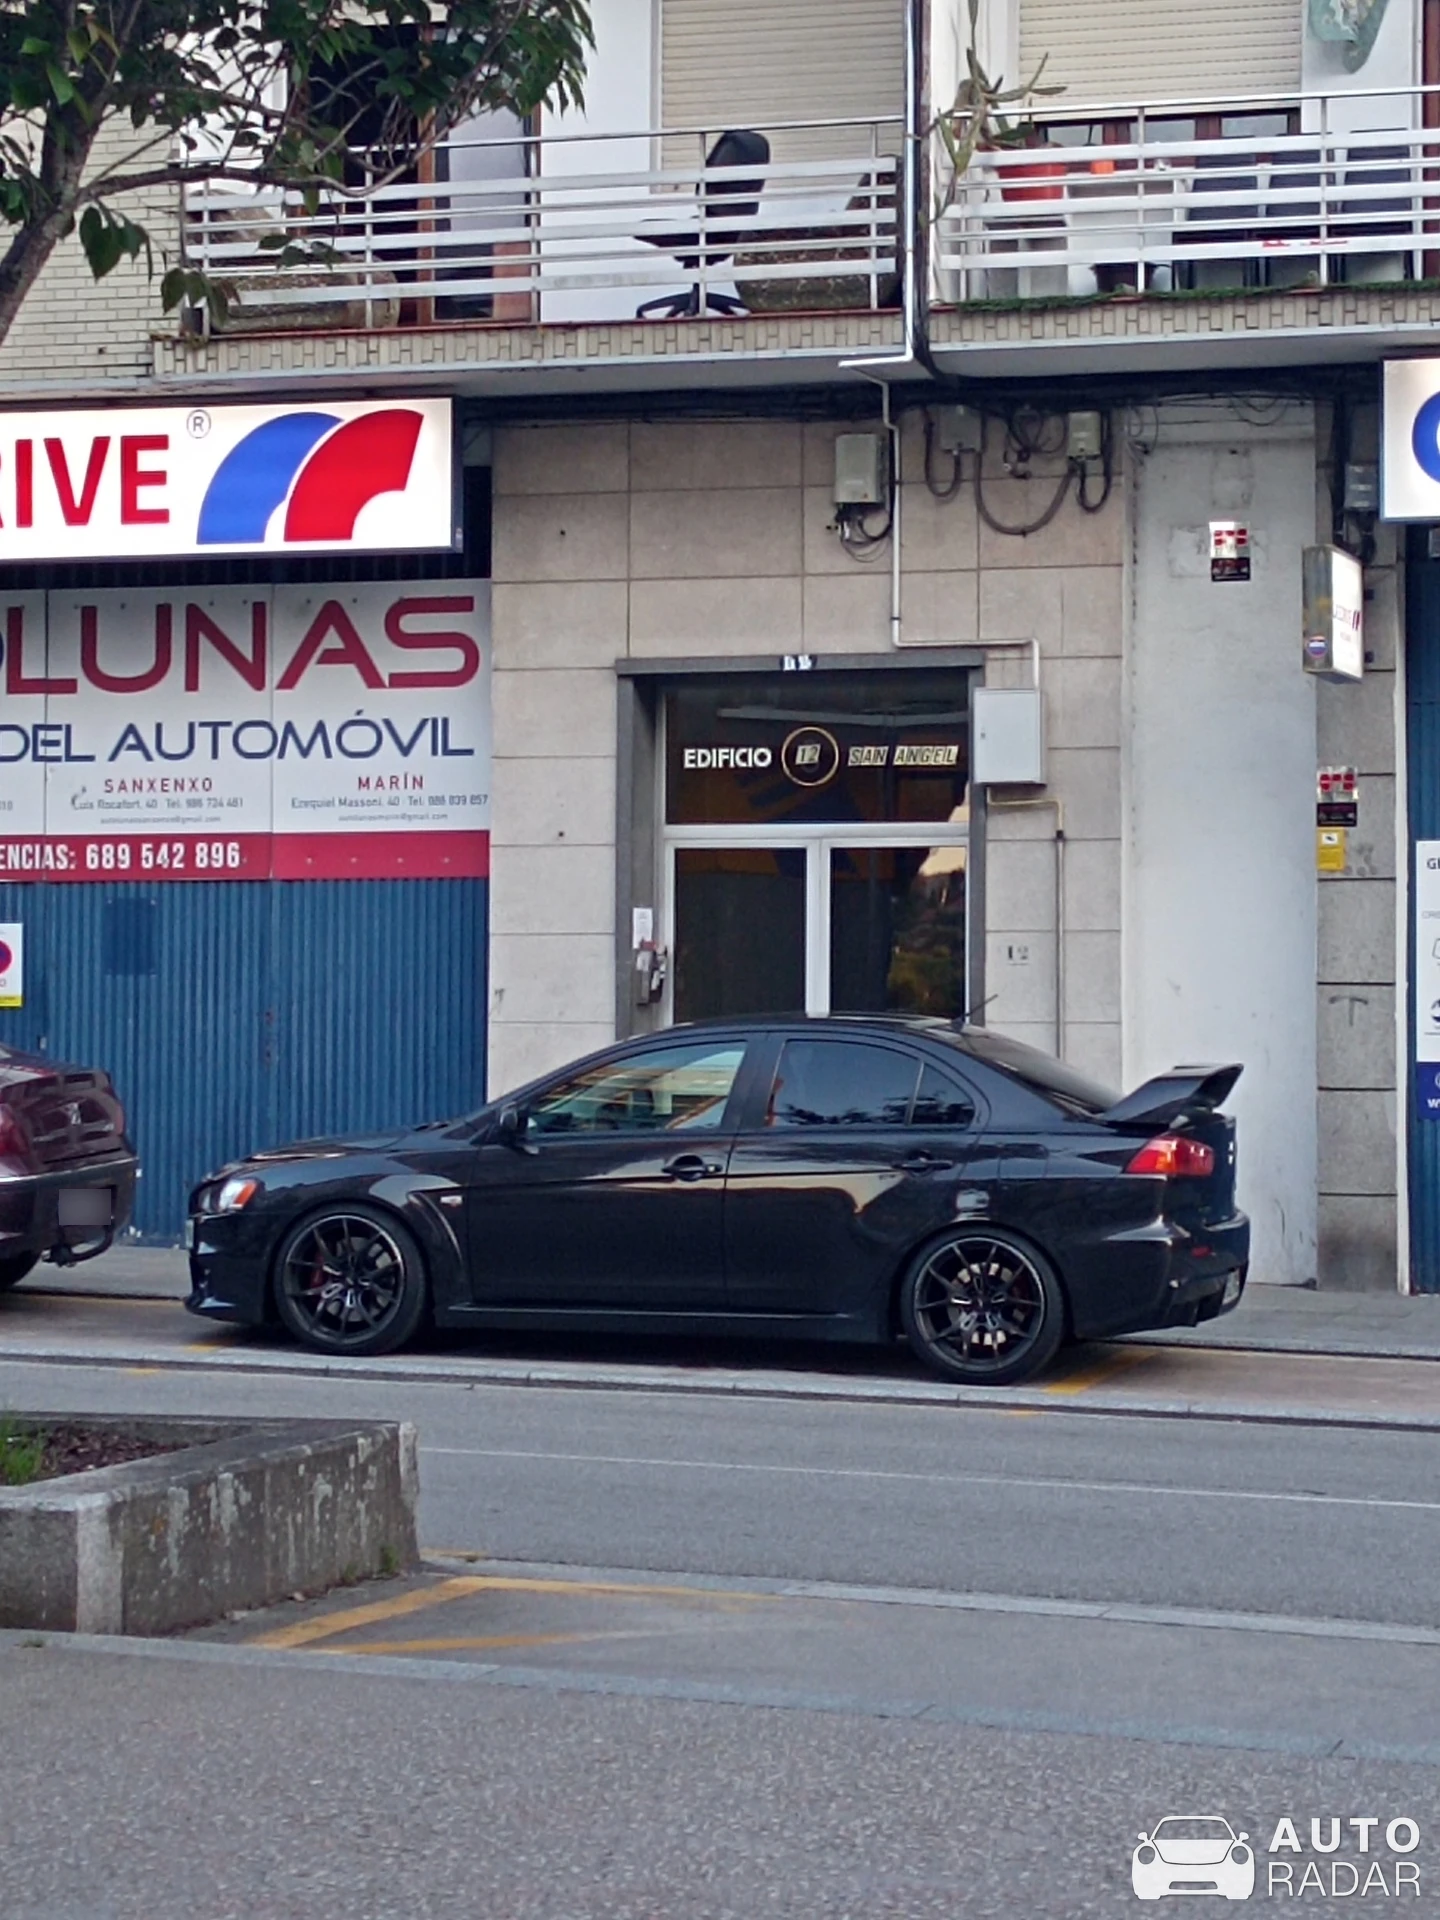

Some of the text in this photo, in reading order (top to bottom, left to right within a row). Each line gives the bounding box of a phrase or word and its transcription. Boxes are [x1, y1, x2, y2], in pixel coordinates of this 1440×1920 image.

[0, 434, 170, 528] IVE
[0, 596, 481, 695] LUNAS
[0, 709, 475, 763] DEL AUTOMÓVIL
[684, 745, 958, 769] EDIFICIO 12 SAN ANGEL
[104, 777, 214, 794] SANXENXO
[357, 773, 425, 790] MARÍN
[86, 843, 131, 870] 689
[141, 842, 185, 869] 542
[195, 842, 240, 868] 896
